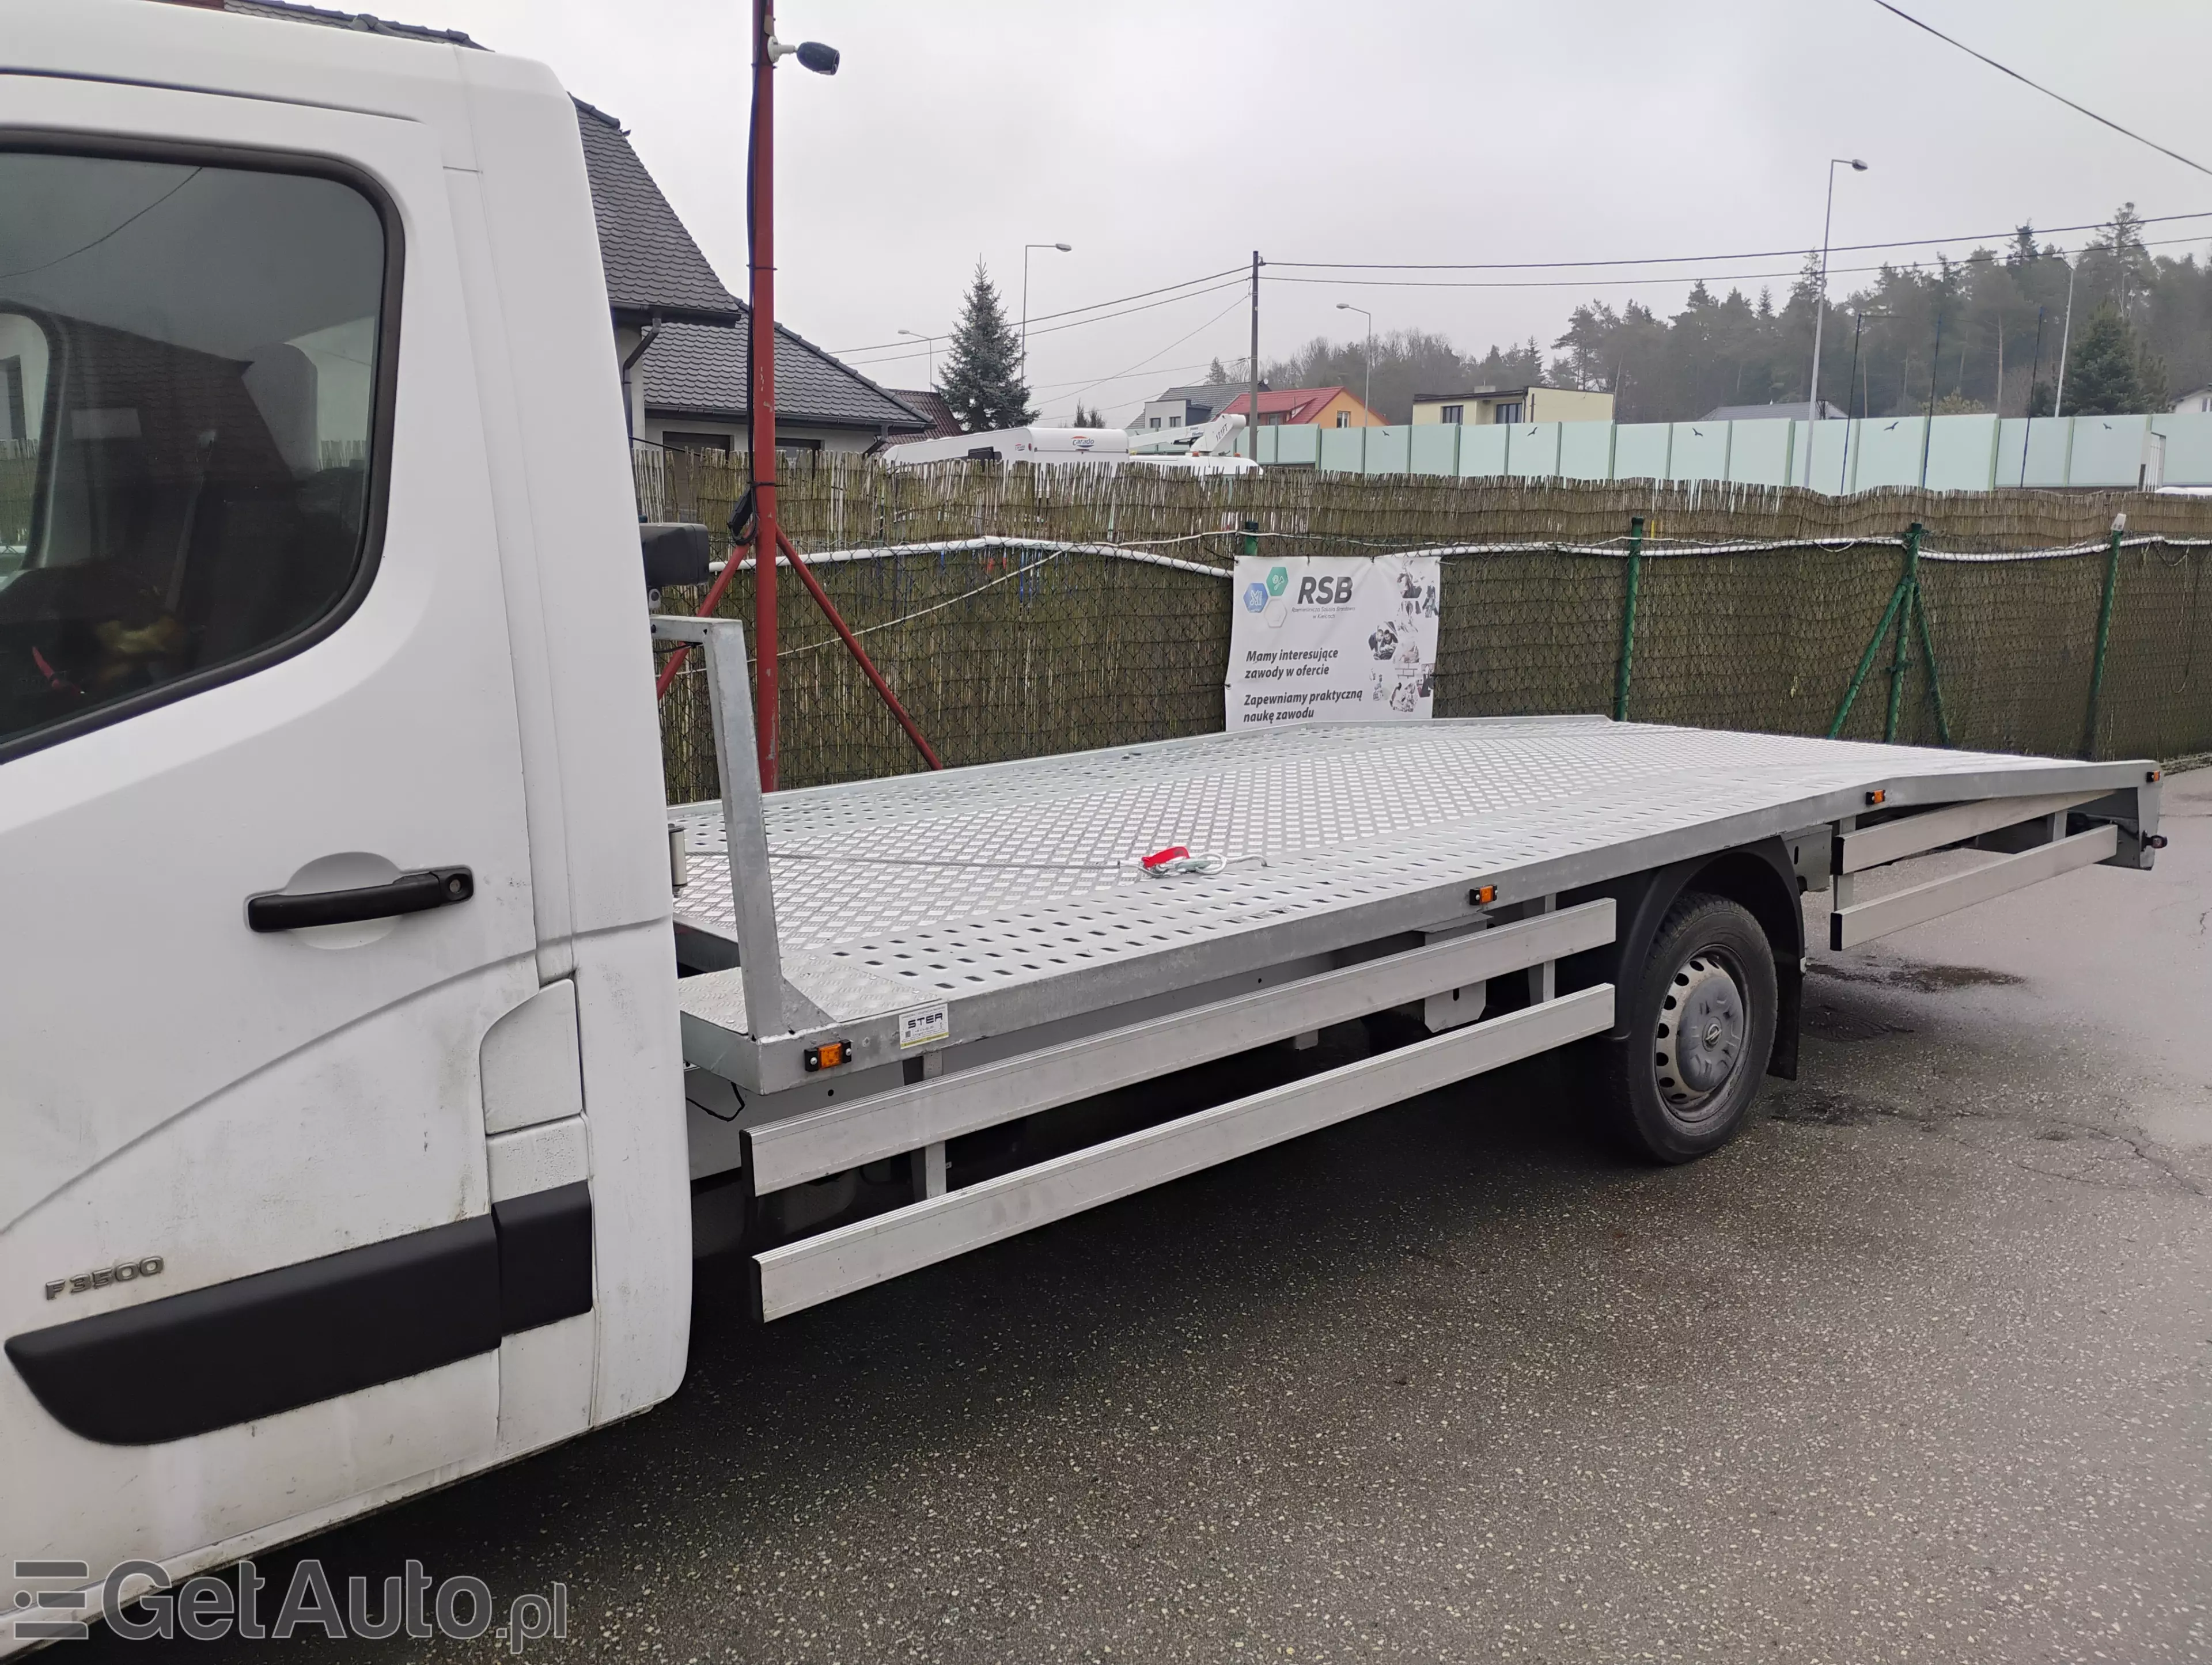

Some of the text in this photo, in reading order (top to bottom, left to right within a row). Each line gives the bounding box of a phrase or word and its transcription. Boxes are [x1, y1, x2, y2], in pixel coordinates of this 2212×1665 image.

[1215, 423, 1228, 442] 121FT
[1297, 577, 1353, 605] RSB
[1246, 648, 1338, 664] Mamy interesujące
[1245, 664, 1330, 680] zawody w ofercie
[1244, 689, 1363, 707] Zapewniamy praktyczną
[1243, 707, 1314, 723] naukę zawodu
[908, 1013, 942, 1029] STER
[46, 1256, 164, 1300] F3500
